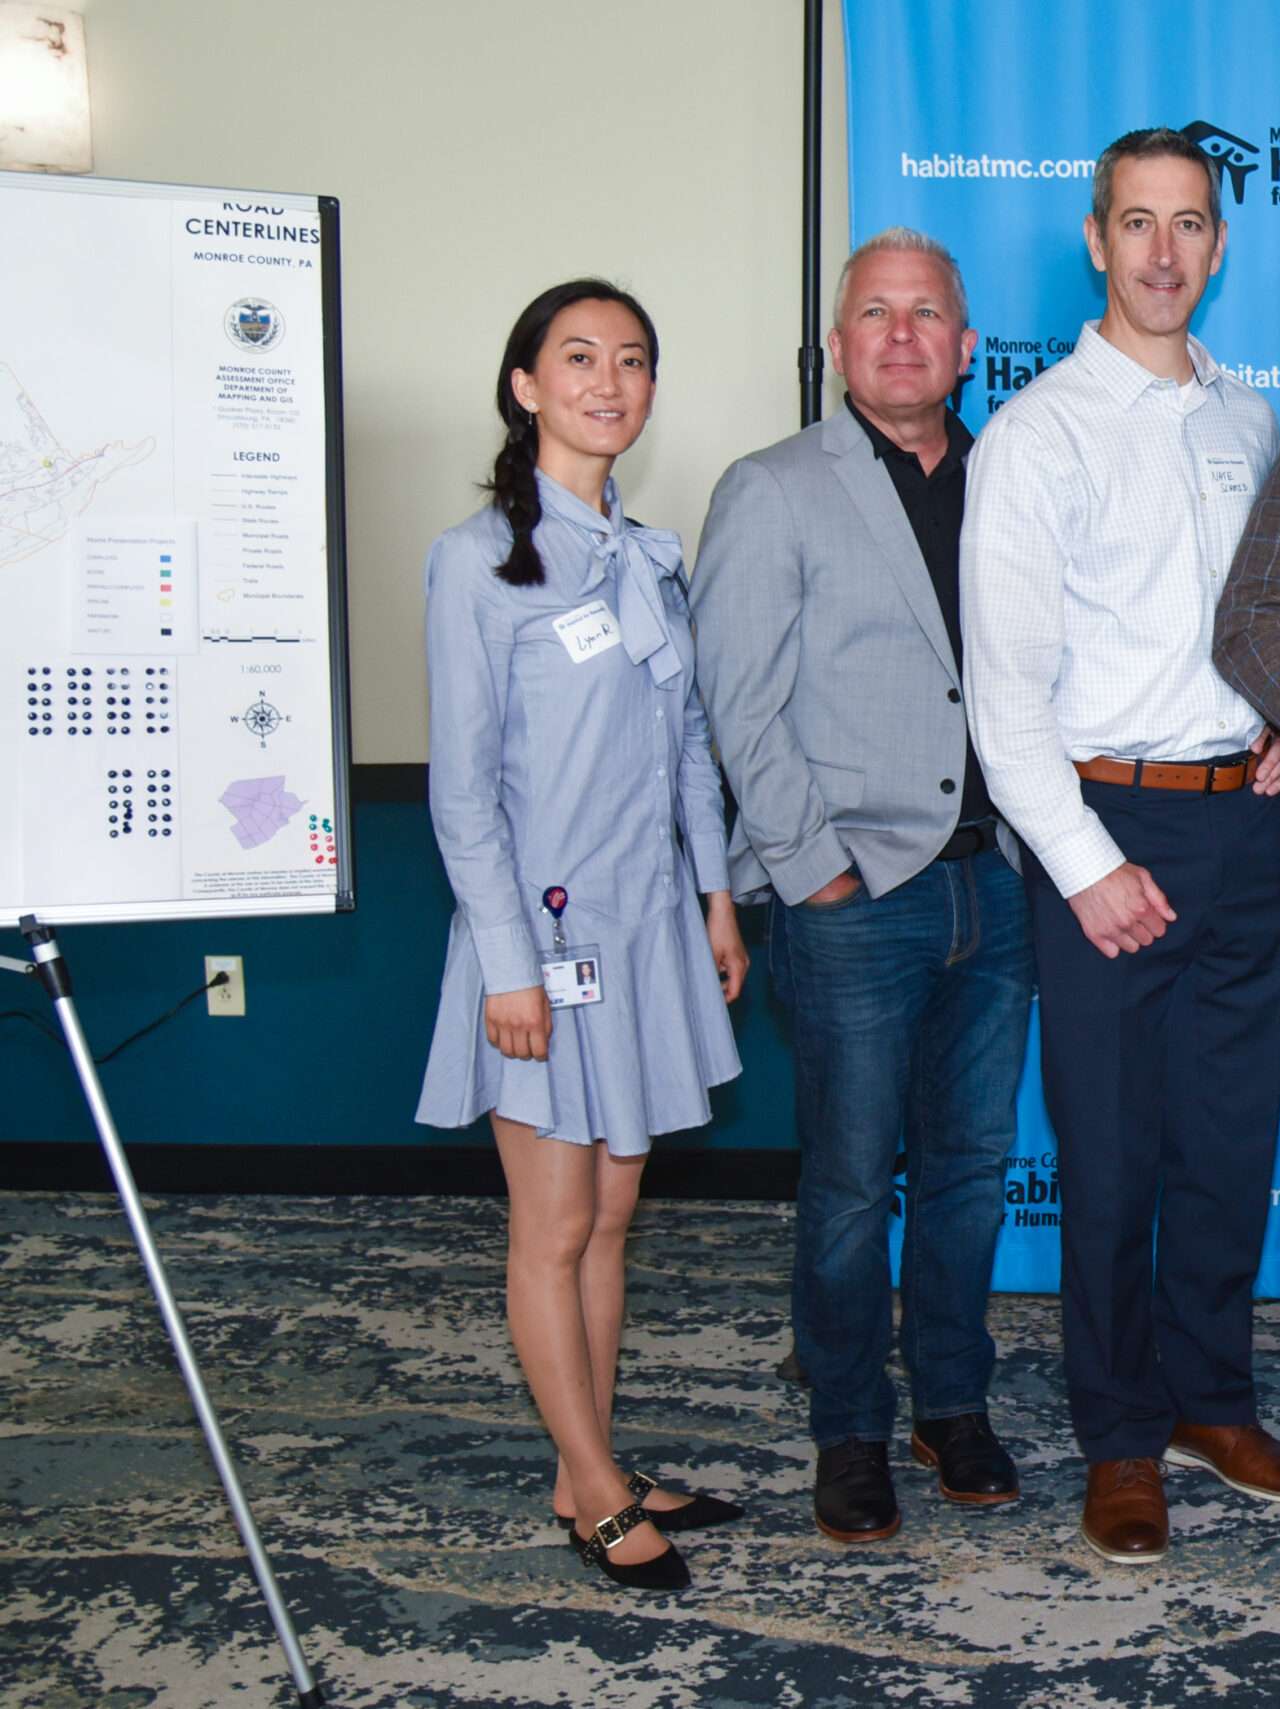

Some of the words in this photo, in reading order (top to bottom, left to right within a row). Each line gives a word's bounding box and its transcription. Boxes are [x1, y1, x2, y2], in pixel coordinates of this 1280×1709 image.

[901, 151, 1096, 178] habitatmc.com
[186, 218, 320, 244] CENTERLINES
[193, 251, 243, 263] MONROE
[299, 260, 312, 268] PA
[986, 336, 1042, 353] Monroe
[218, 366, 256, 374] MONROE
[258, 368, 291, 376] COUNTY
[233, 451, 281, 462] LEGEND
